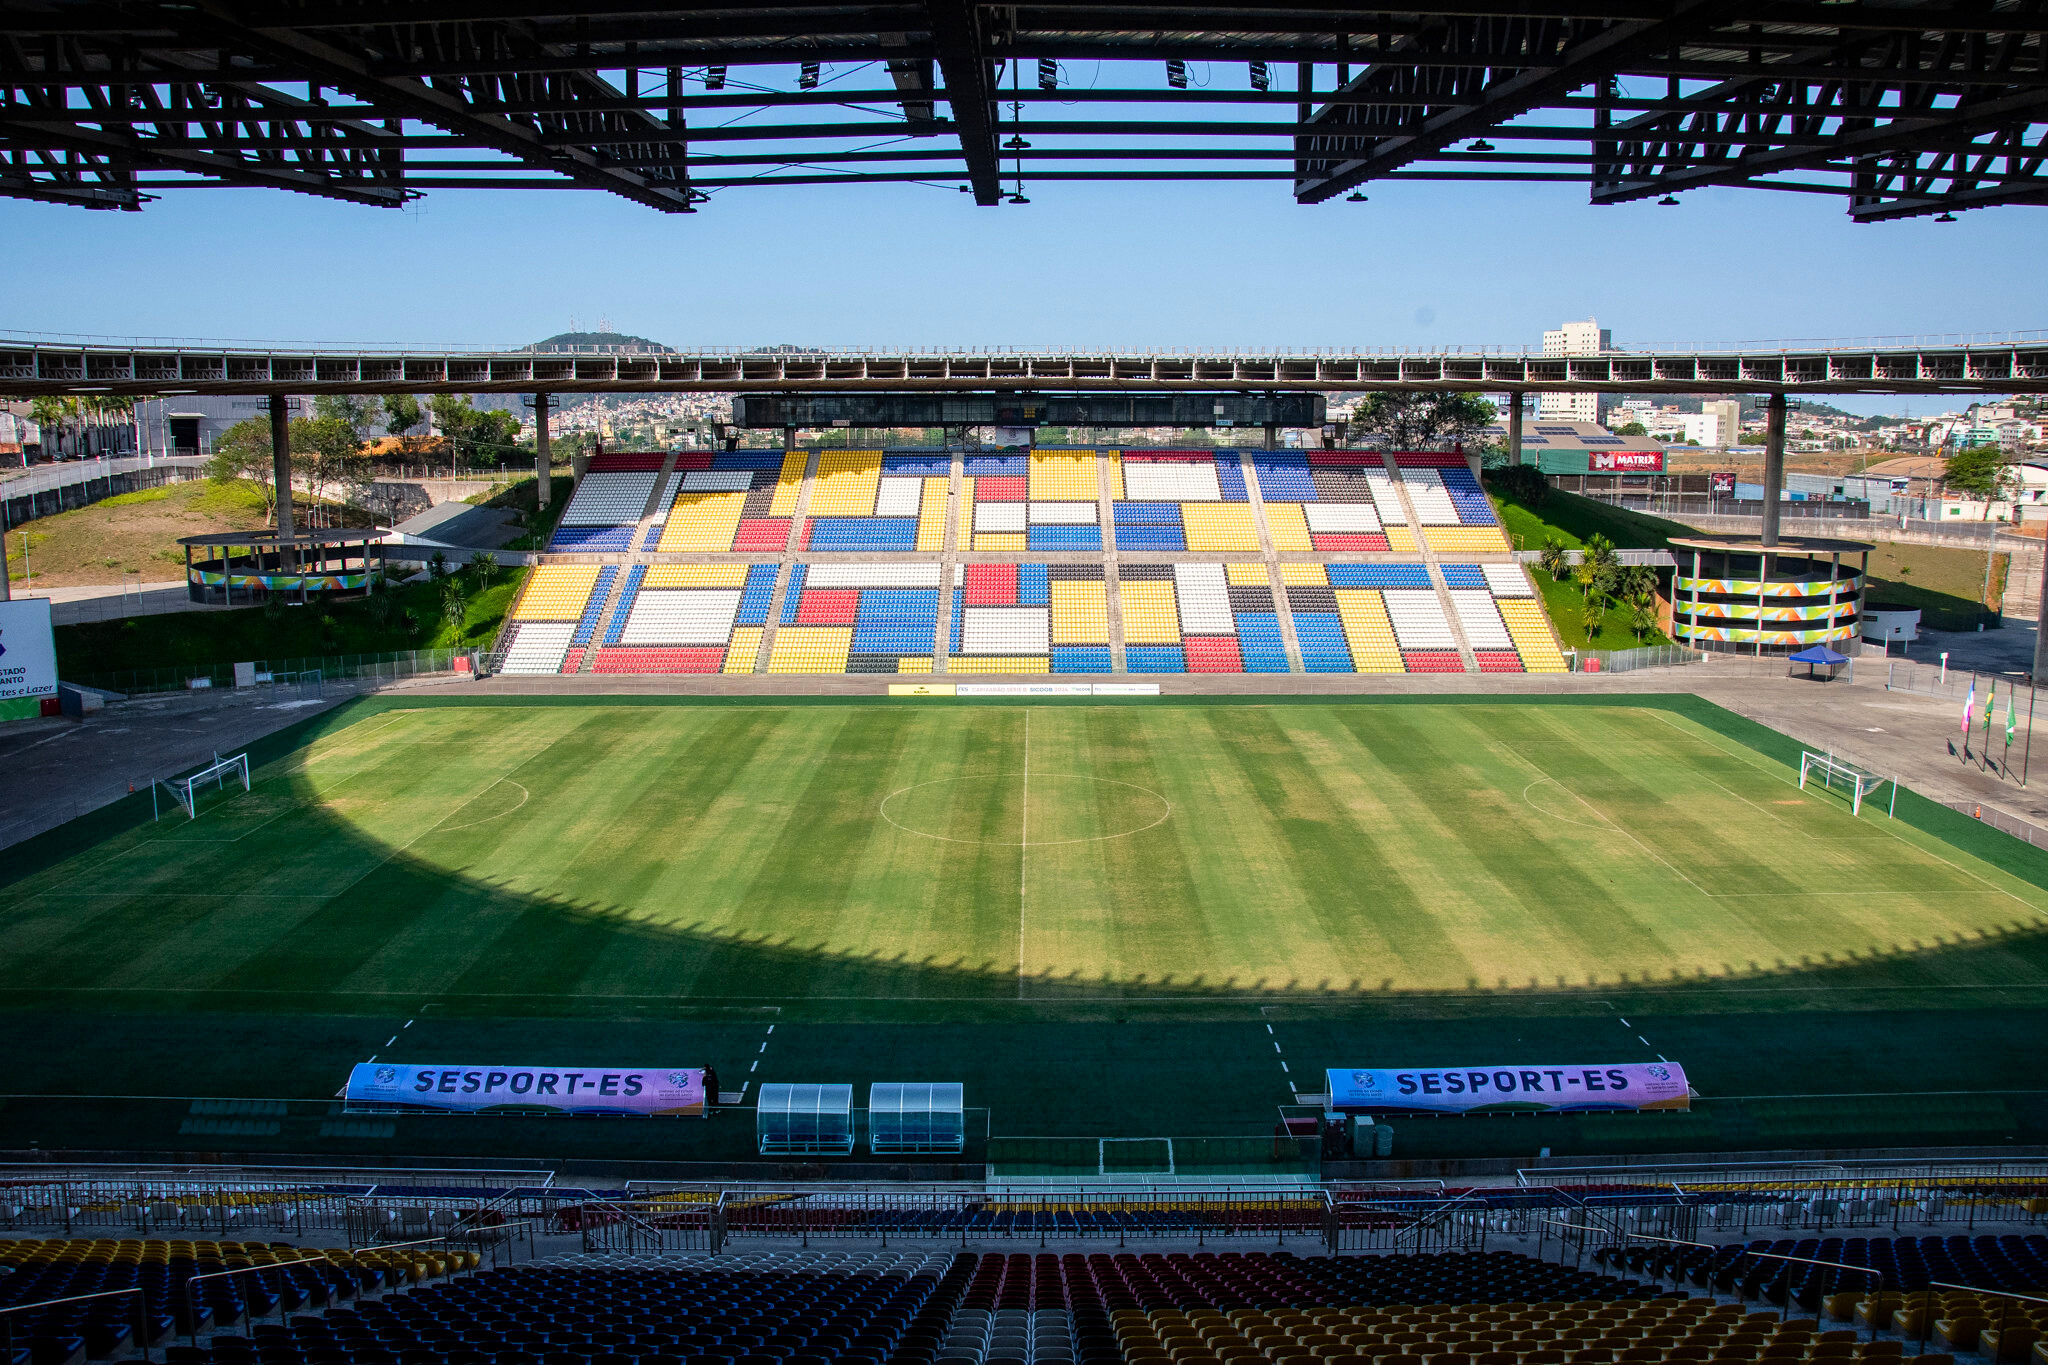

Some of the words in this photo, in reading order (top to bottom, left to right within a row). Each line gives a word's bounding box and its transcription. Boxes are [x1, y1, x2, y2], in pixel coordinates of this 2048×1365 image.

[1617, 455, 1655, 464] MATRIX
[27, 685, 54, 694] Lazer
[414, 1071, 643, 1096] SESPORT-ES
[1396, 1069, 1628, 1095] SESPORT-ES
